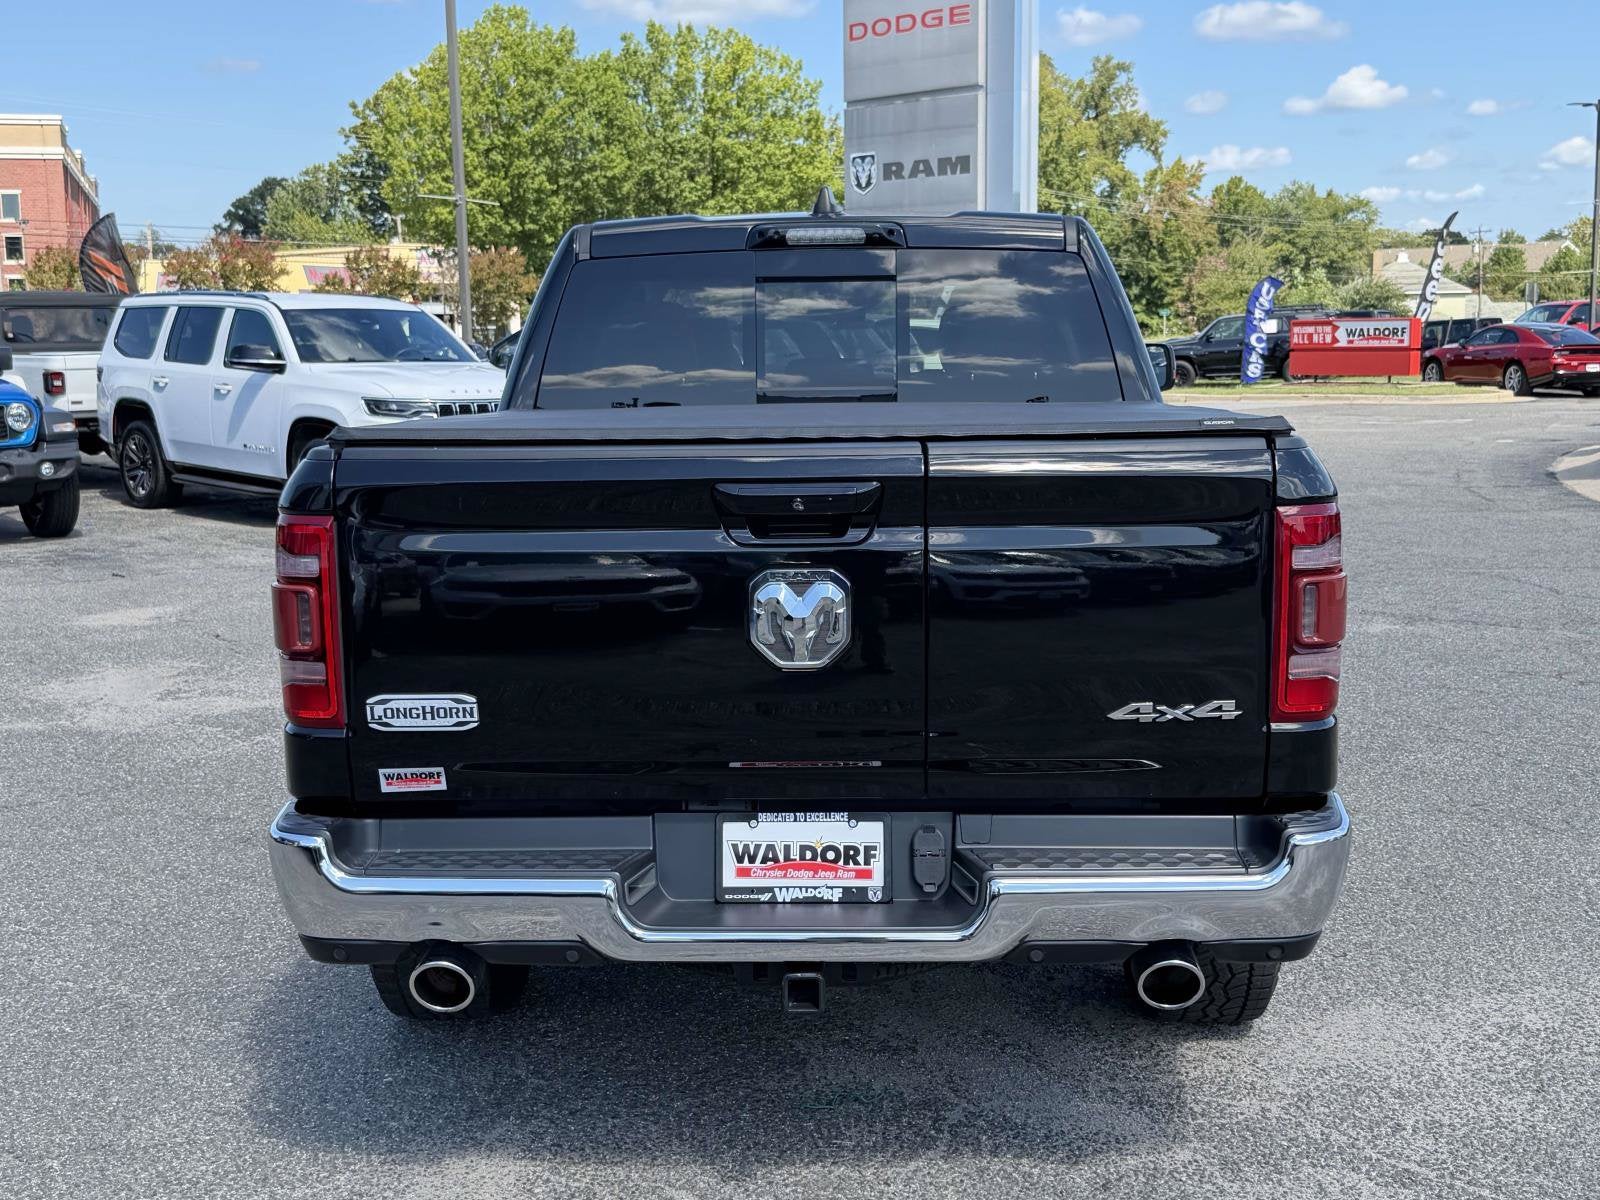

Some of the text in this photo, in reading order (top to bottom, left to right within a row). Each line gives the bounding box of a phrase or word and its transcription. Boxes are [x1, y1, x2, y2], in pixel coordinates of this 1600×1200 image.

[849, 4, 971, 42] DODGE
[882, 155, 971, 181] RAM
[1293, 333, 1332, 344] ALL NEW
[1345, 327, 1407, 338] WALDORF
[768, 572, 831, 581] RAM
[368, 705, 476, 721] LONGHORN
[1106, 700, 1244, 722] 4x4
[383, 771, 443, 781] WALDORF
[758, 812, 849, 822] DEDICATED TO EXCELLENCE
[728, 841, 879, 867] WALDORF
[750, 868, 856, 879] Chrysler Dodge Jeep Ram
[774, 887, 843, 902] WALDORF
